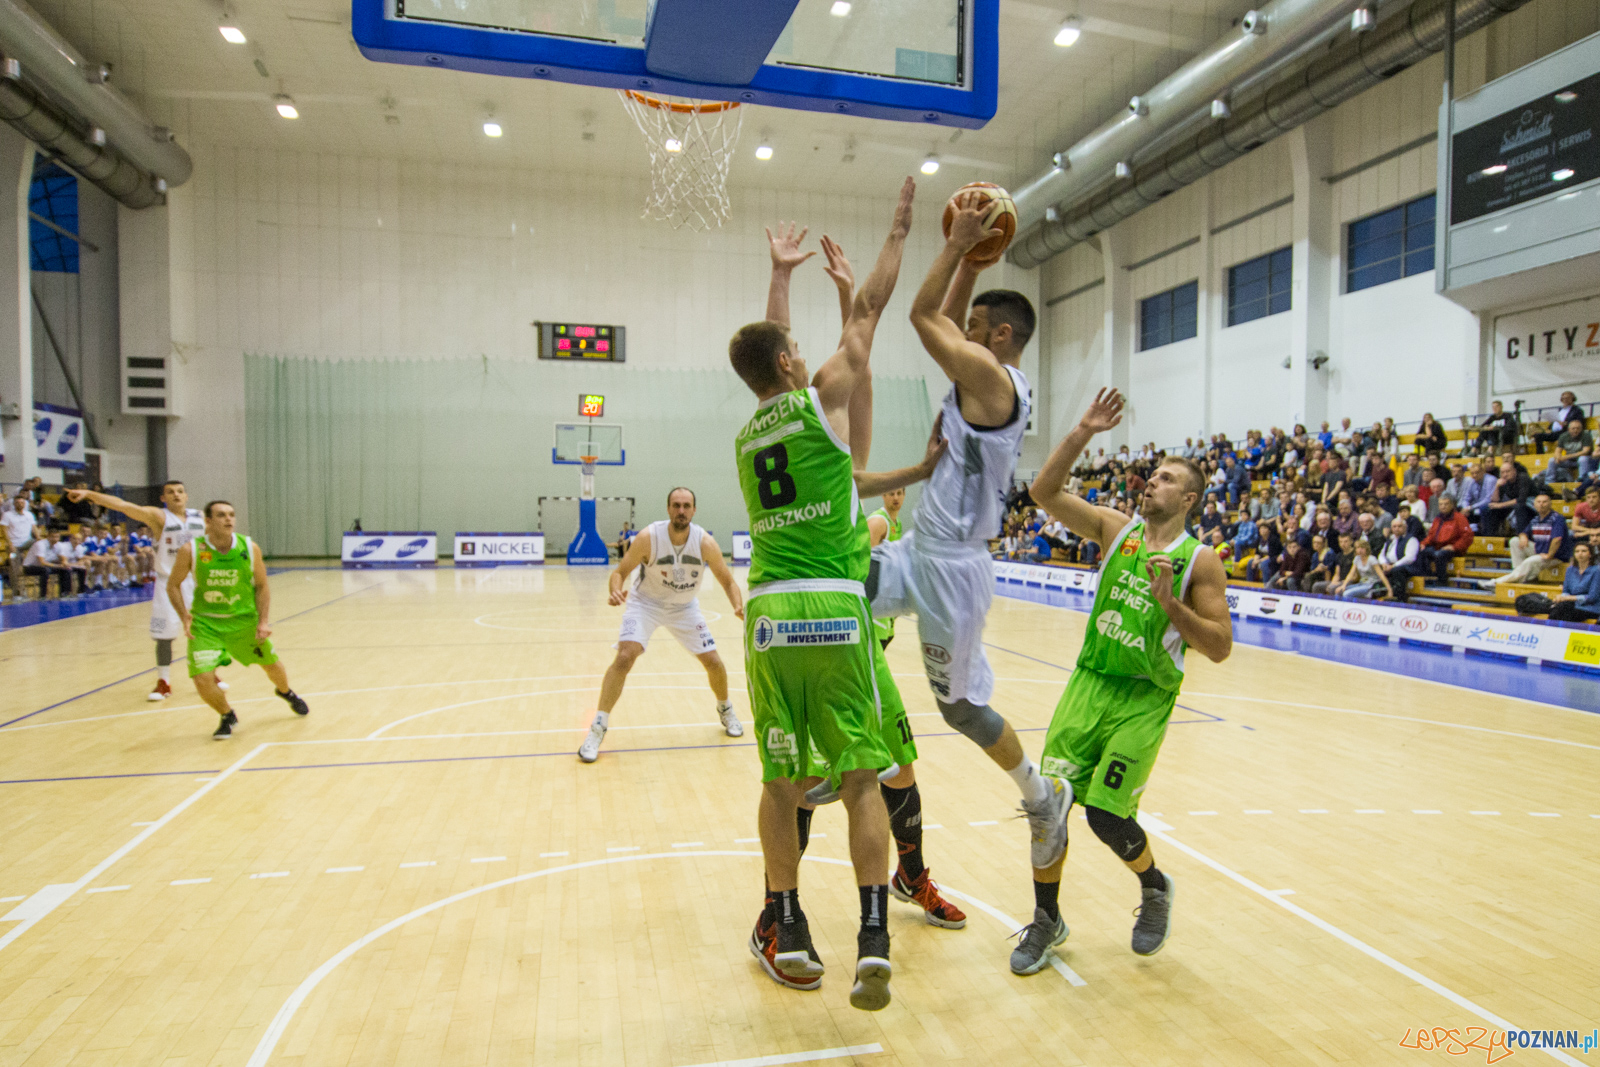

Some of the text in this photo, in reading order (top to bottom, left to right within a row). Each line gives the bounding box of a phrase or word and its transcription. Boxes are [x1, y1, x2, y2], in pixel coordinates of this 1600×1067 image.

[583, 402, 598, 413] 20
[754, 443, 796, 510] 8
[752, 500, 831, 537] PRUSZKÓW
[482, 542, 539, 554] NICKEL
[1173, 558, 1186, 575] 6
[777, 619, 858, 634] ELEKTROBUD
[1303, 606, 1337, 620] NICKEL
[1371, 614, 1396, 626] DELIK
[1405, 620, 1423, 630] KIA
[1433, 623, 1463, 635] DELIK
[787, 632, 851, 644] INVESTMENT
[1487, 628, 1540, 645] funclub
[1103, 760, 1127, 790] 6
